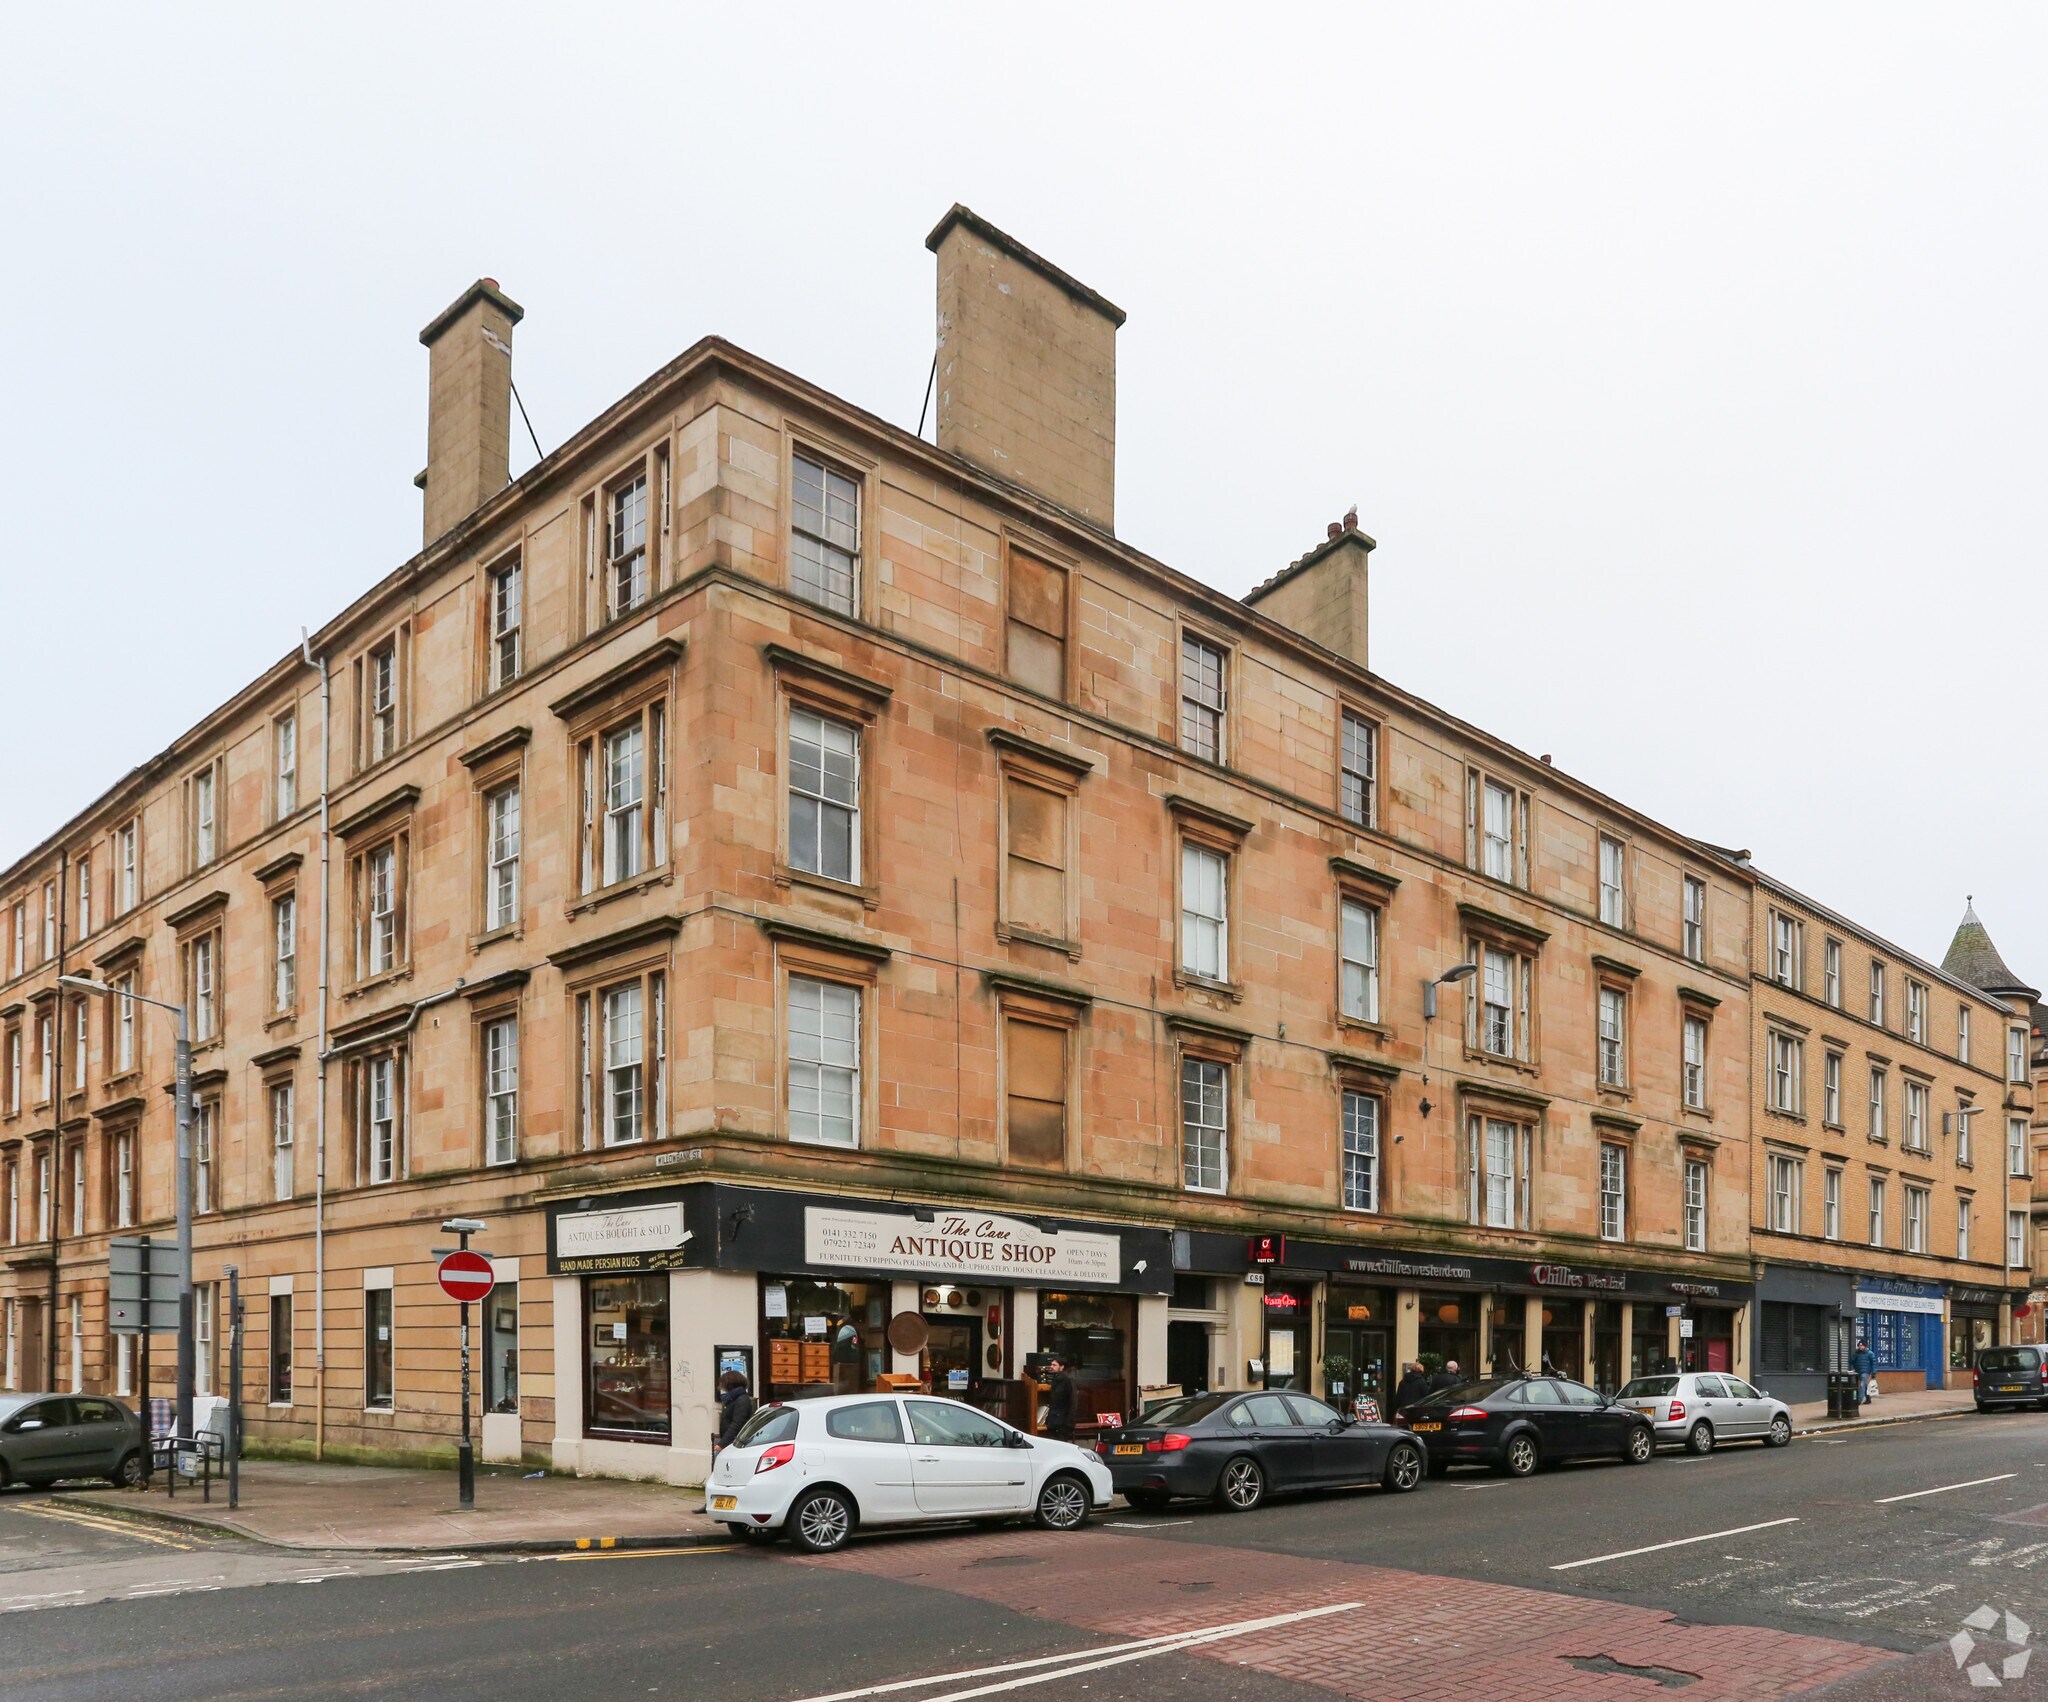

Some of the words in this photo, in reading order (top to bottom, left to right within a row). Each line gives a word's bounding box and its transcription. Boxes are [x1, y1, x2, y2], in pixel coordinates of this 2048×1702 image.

[567, 1230, 605, 1243] ANTIQUES
[606, 1227, 638, 1239] BOUGHT
[639, 1227, 646, 1237] &
[648, 1224, 671, 1235] SOLD
[822, 1228, 840, 1237] 0141
[843, 1230, 857, 1239] 332
[859, 1231, 877, 1240] 7150
[941, 1216, 969, 1237] The
[975, 1219, 1011, 1240] Cave
[823, 1238, 851, 1248] 079221
[853, 1241, 876, 1250] 72349
[889, 1235, 994, 1263] ANTIQUE
[1001, 1243, 1056, 1264] SHOP
[1066, 1248, 1084, 1257] OPEN
[1090, 1250, 1107, 1258] DAYS
[560, 1261, 577, 1271] HAND
[577, 1259, 594, 1270] MADE
[594, 1258, 621, 1269] PERSIAN
[621, 1256, 640, 1267] RUGS
[902, 1259, 941, 1269] POLISHING
[941, 1261, 957, 1269] AND
[1012, 1266, 1034, 1274] HOUSE
[1035, 1267, 1072, 1277] CLEARANCE
[1079, 1271, 1108, 1279] DELIVERY
[1349, 1259, 1471, 1278] www.chillieswestend.com
[1533, 1264, 1584, 1288] Chillies
[1586, 1273, 1607, 1288] West
[1609, 1273, 1626, 1291] End
[1886, 1298, 1900, 1307] ESTATE
